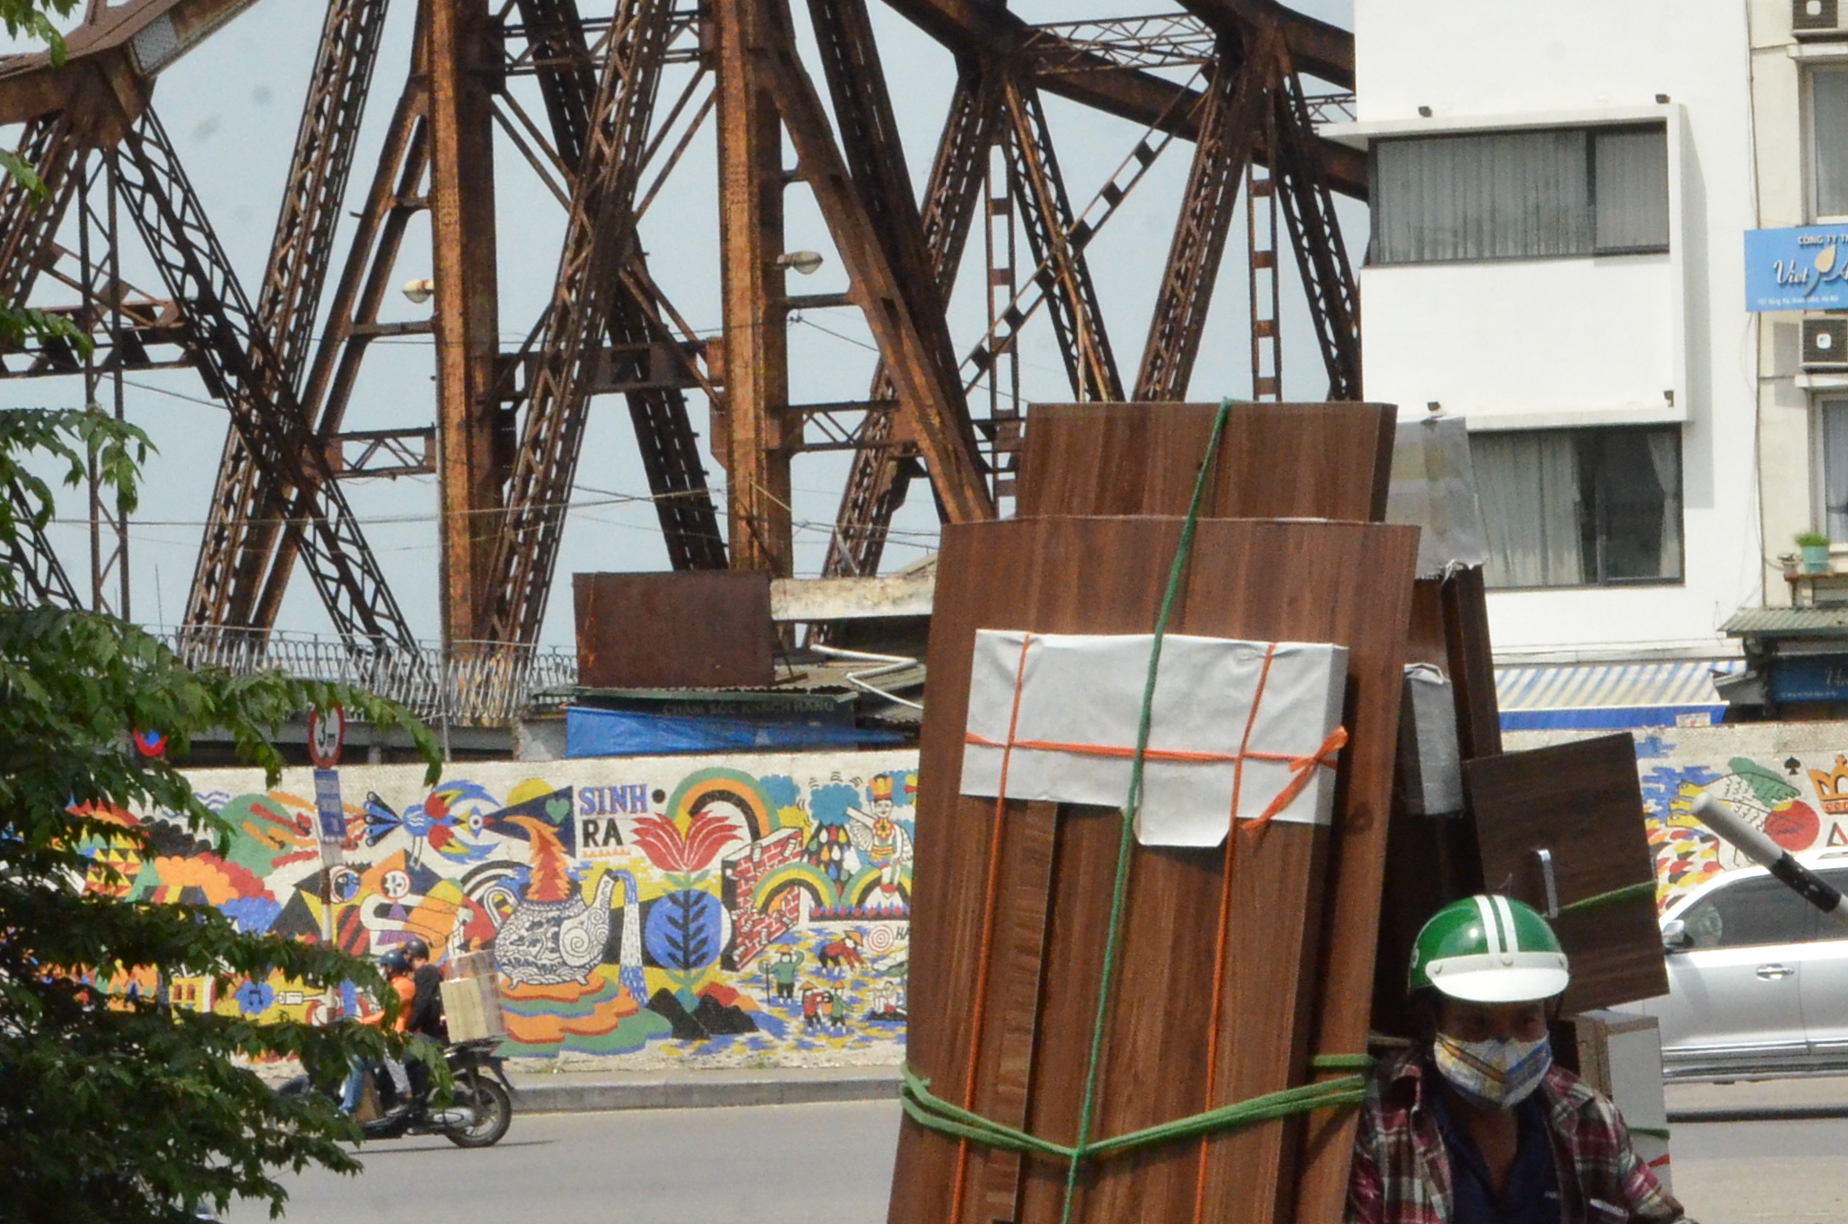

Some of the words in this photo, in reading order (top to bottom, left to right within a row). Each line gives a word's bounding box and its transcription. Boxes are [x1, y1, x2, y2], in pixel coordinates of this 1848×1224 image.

[1773, 259, 1808, 285] Viet
[578, 783, 648, 816] SINH
[582, 818, 623, 848] RA
